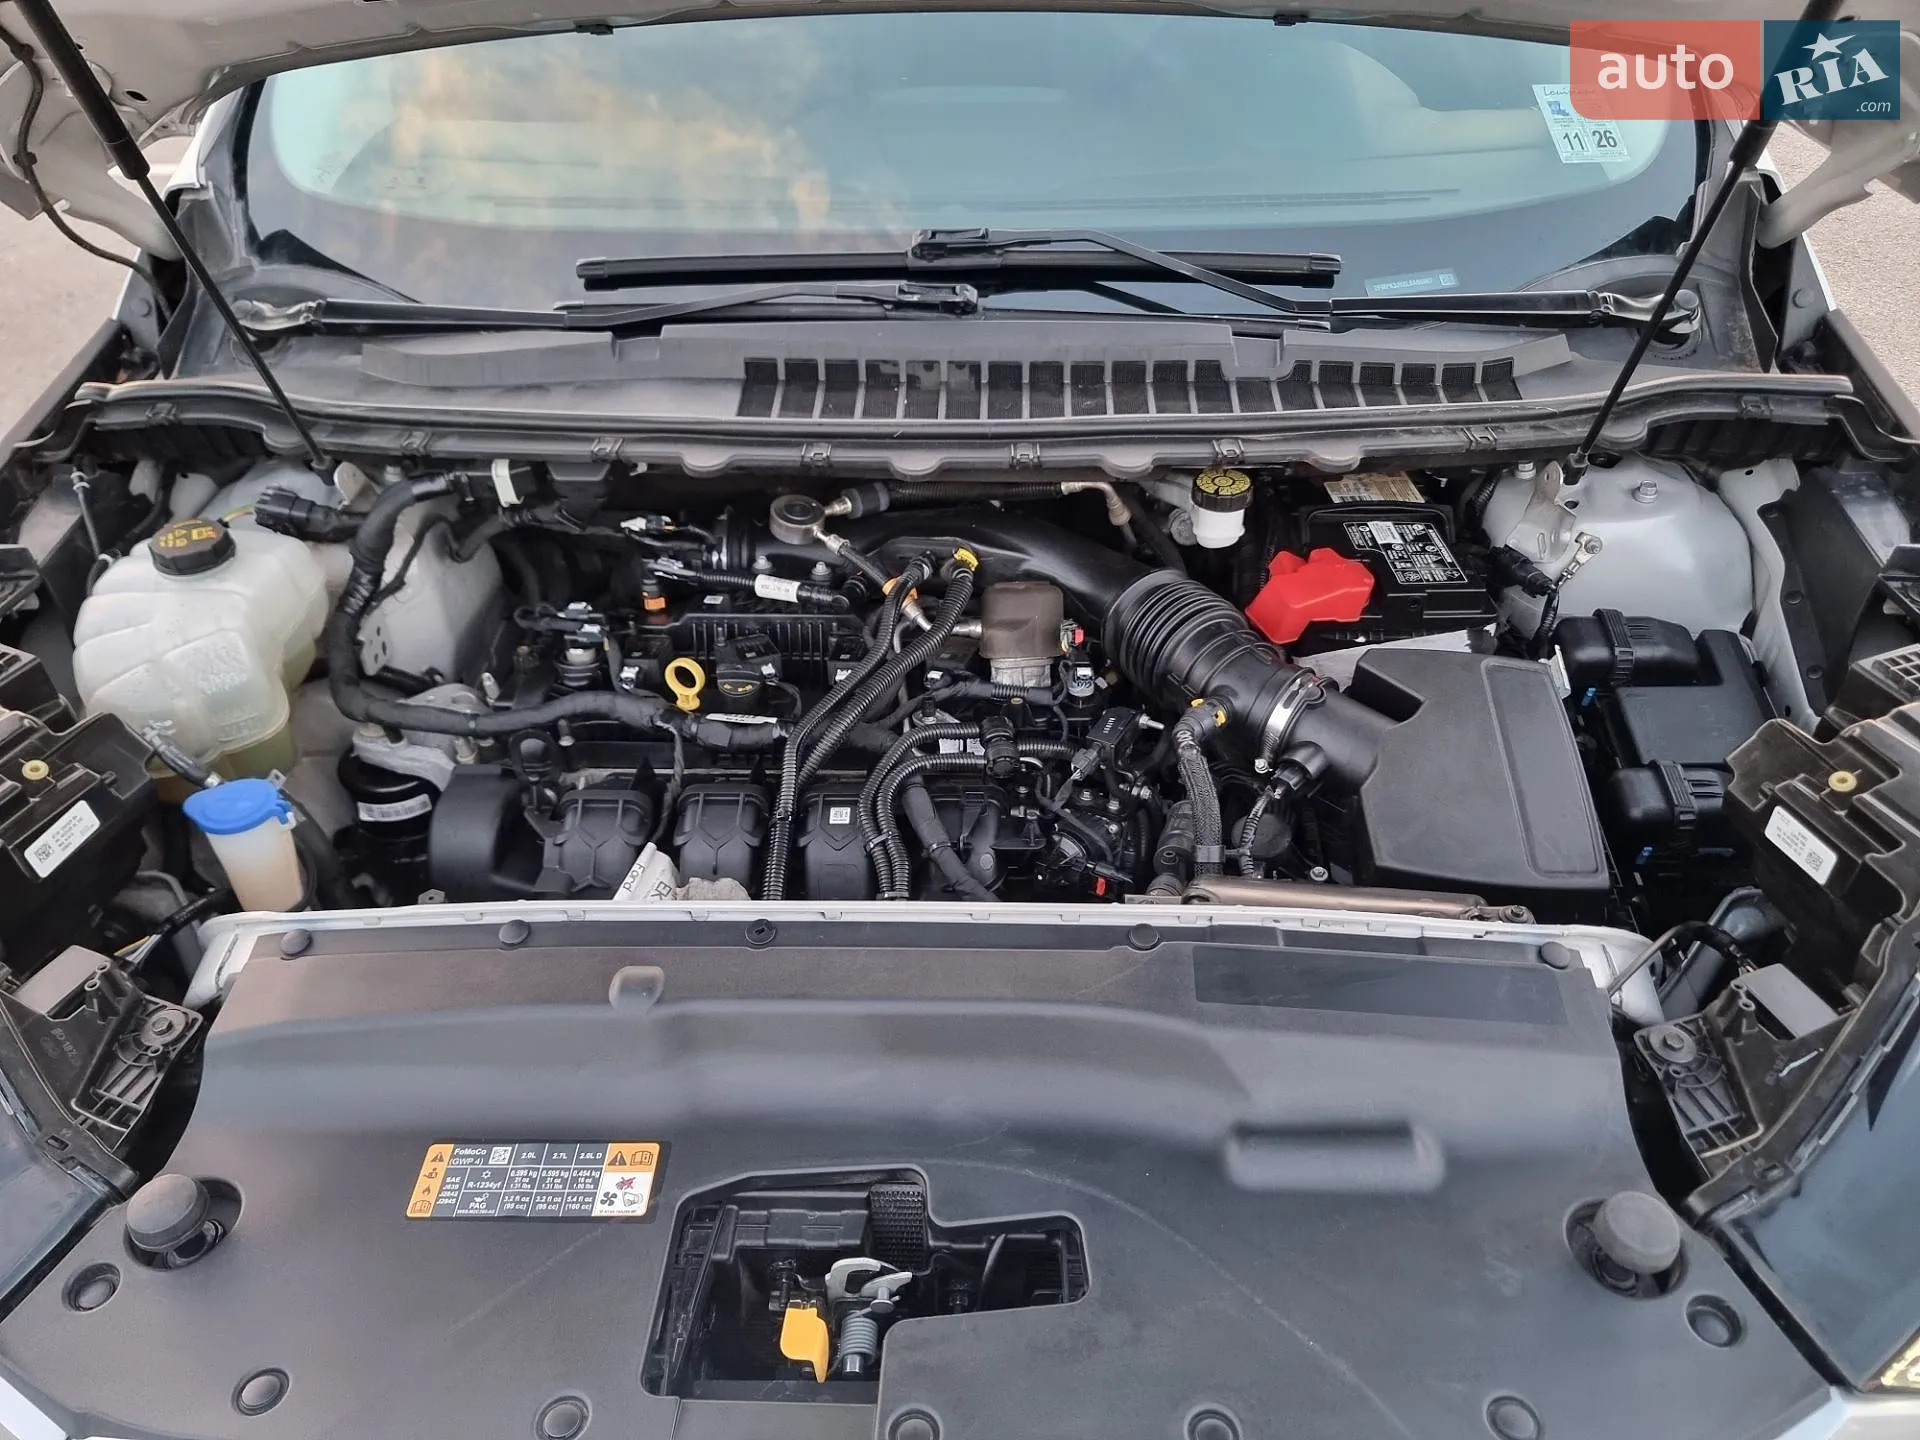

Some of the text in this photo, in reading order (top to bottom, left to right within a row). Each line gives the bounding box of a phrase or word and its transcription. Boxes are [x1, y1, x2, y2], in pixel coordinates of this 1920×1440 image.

[1563, 132, 1585, 151] 11
[1592, 130, 1618, 148] 26
[623, 863, 646, 893] Ford
[449, 1158, 474, 1166] (GWP
[467, 1181, 502, 1190] R-1234yf
